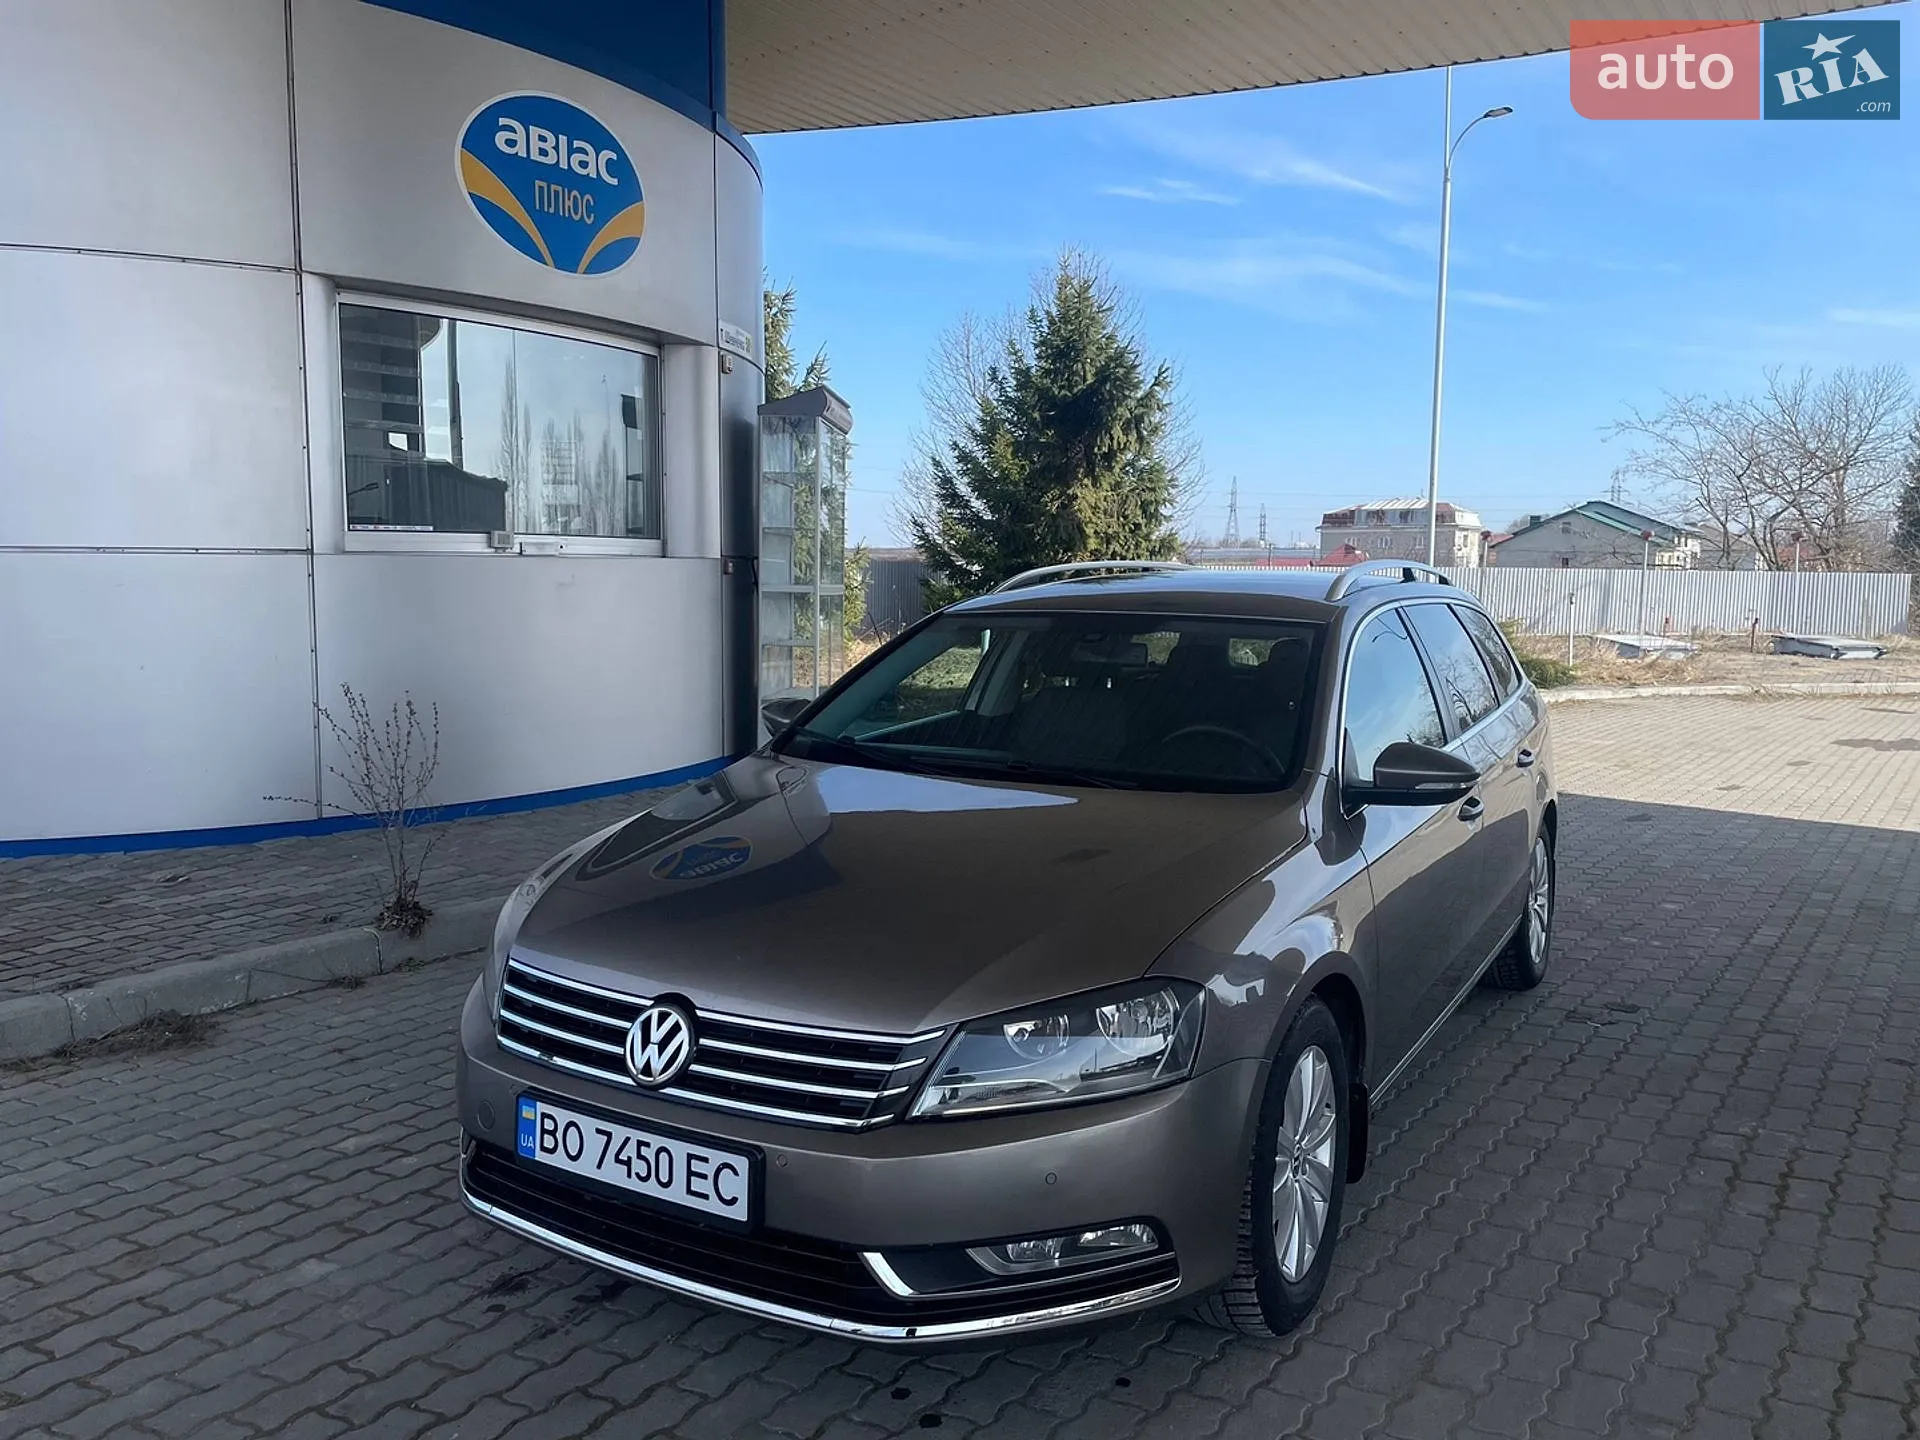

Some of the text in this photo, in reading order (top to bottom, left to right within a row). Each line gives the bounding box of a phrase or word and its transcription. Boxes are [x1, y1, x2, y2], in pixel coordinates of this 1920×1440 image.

[534, 179, 595, 225] ПЛЮС
[520, 1133, 535, 1148] UA
[539, 1111, 740, 1207] BO 7450 EC
